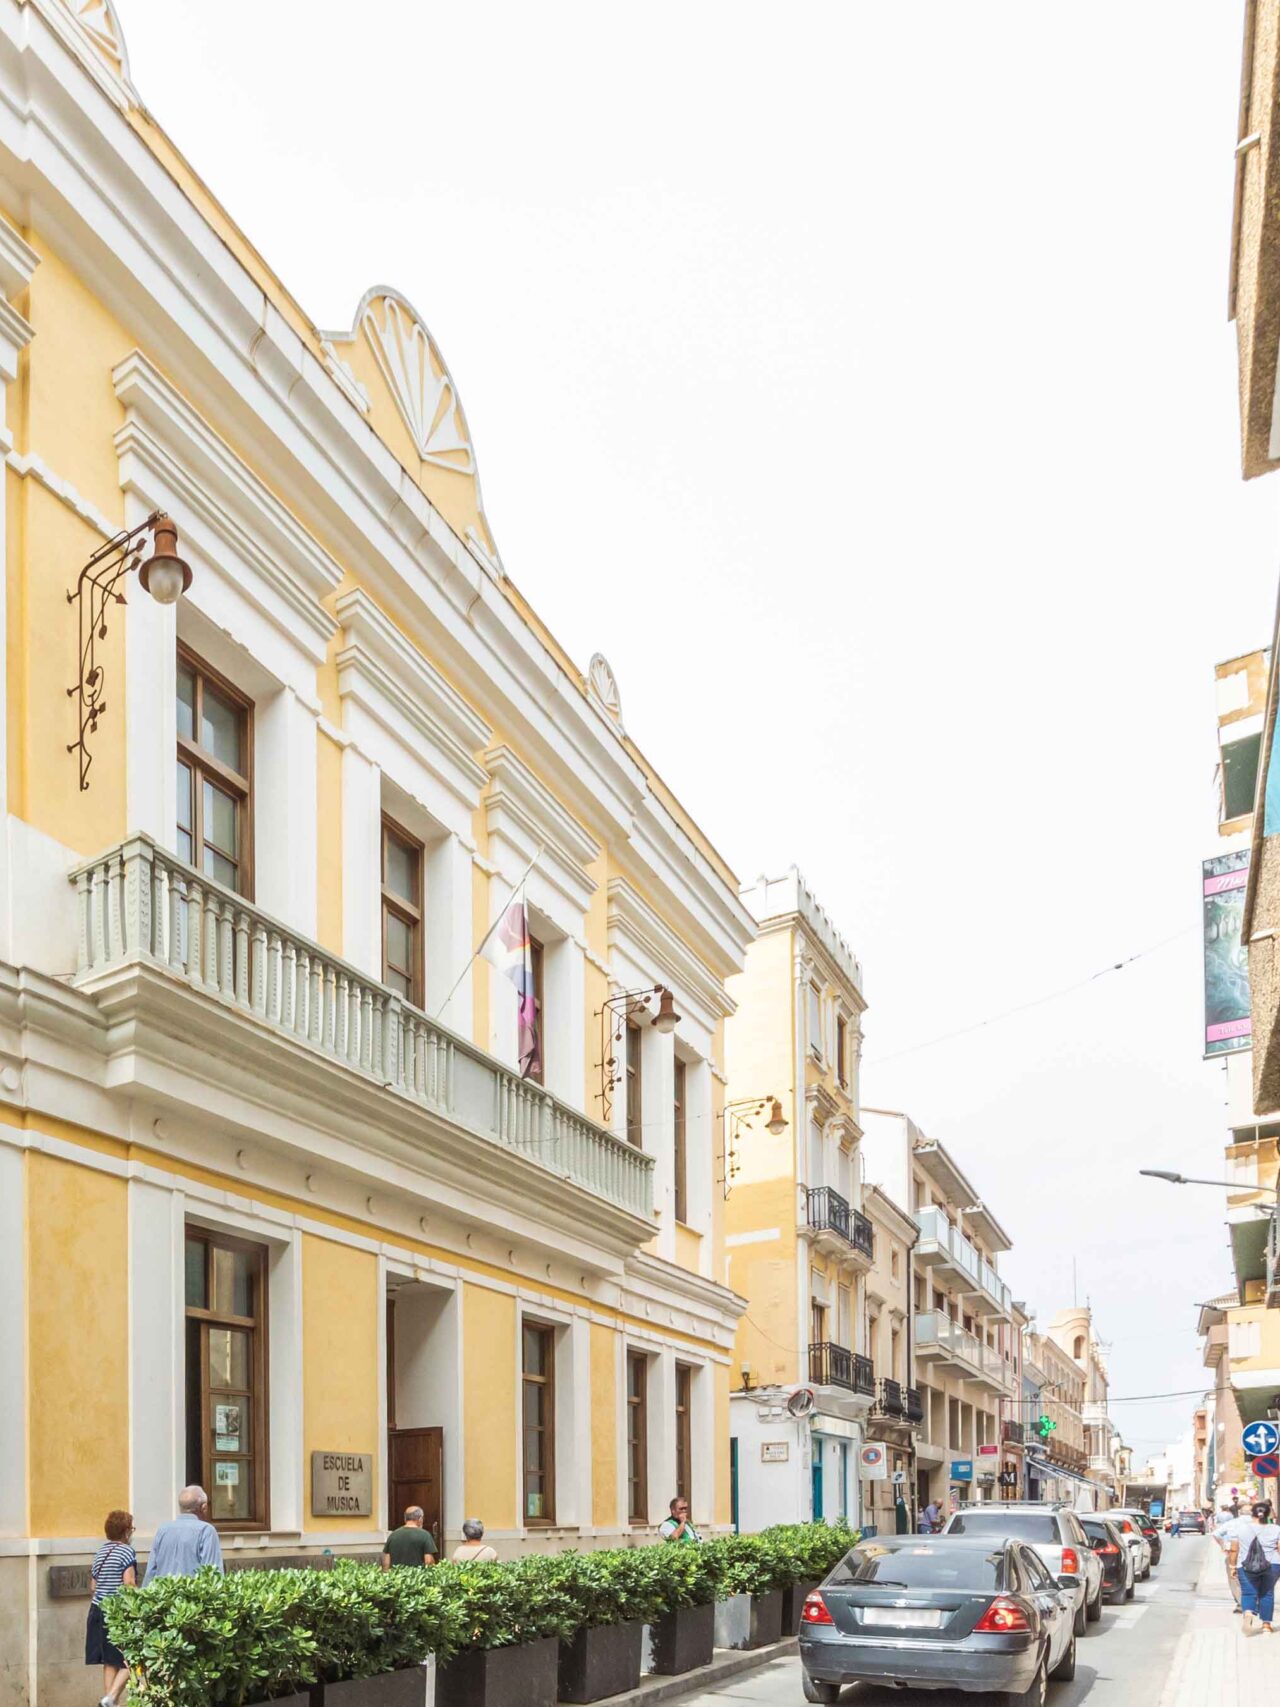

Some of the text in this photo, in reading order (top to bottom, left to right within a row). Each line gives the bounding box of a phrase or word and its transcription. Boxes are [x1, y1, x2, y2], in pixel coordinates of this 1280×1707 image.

[323, 1455, 363, 1472] ESCUELA
[338, 1476, 350, 1491] DE
[327, 1496, 360, 1511] MUSICA
